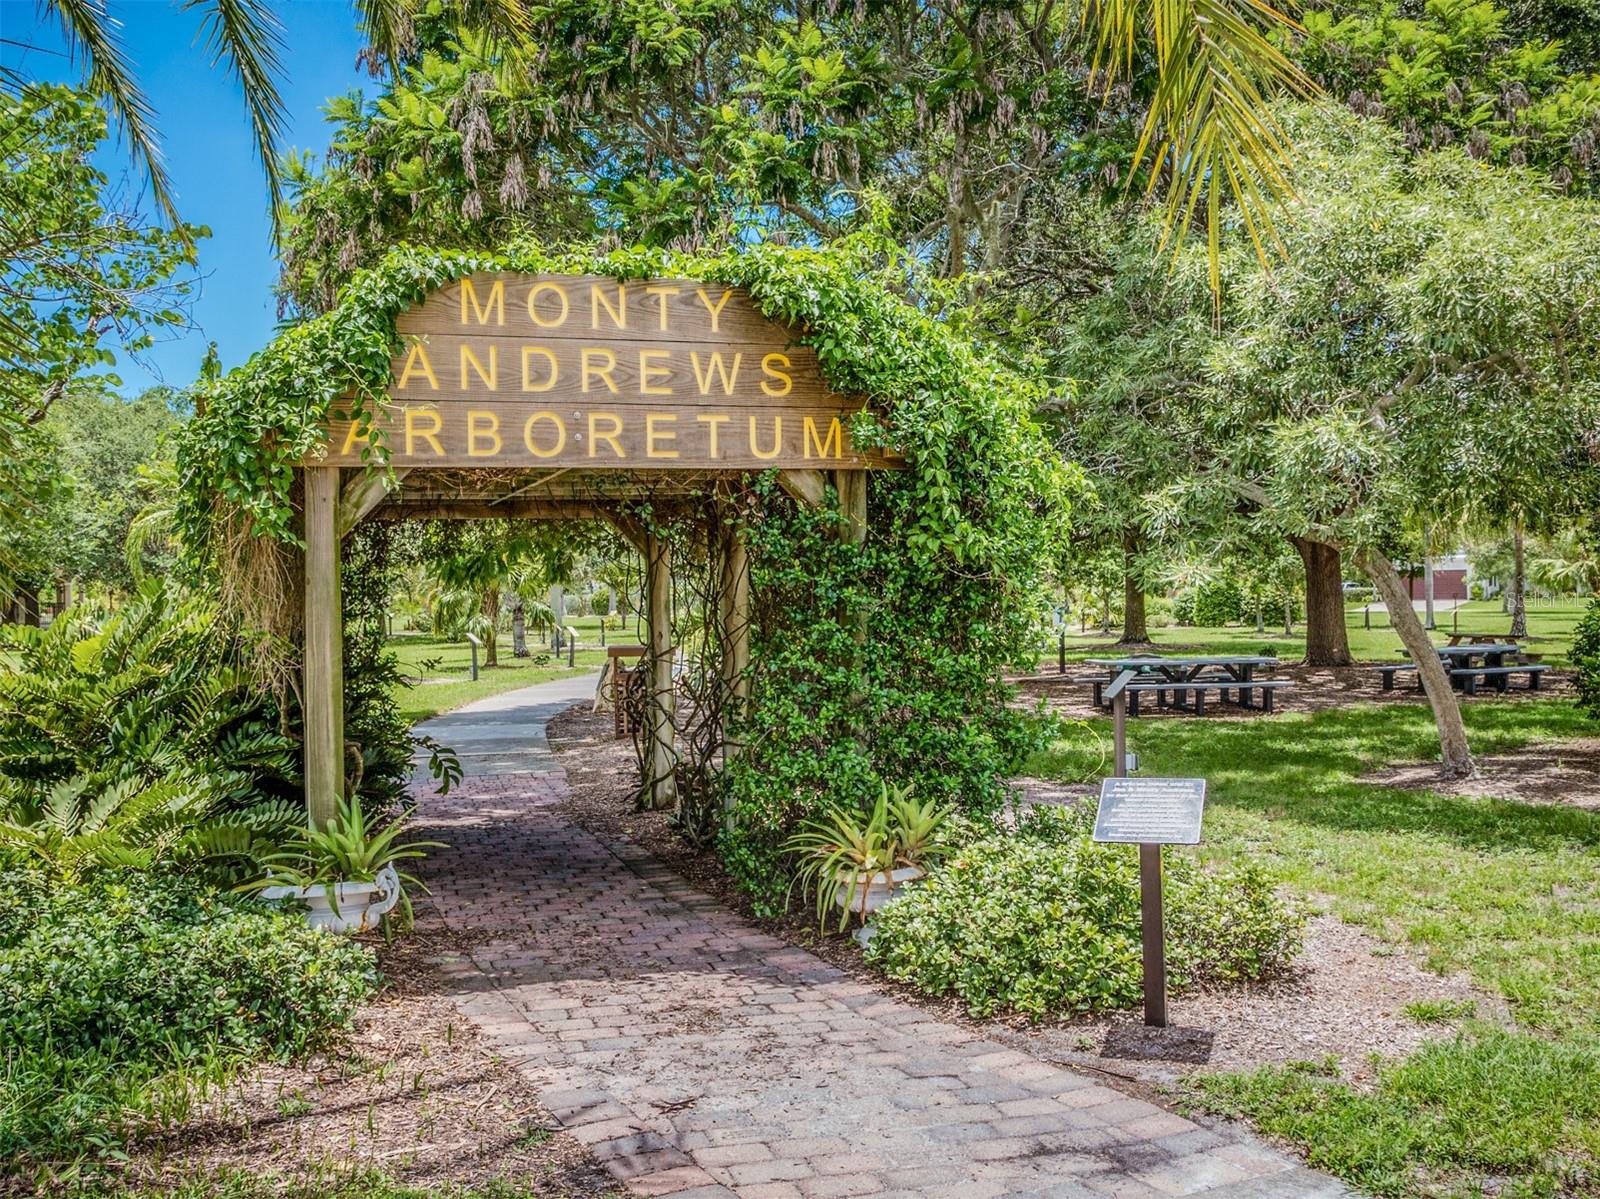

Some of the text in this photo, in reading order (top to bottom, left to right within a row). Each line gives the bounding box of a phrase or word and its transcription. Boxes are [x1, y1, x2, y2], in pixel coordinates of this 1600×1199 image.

[460, 278, 733, 333] MONTY
[398, 343, 793, 397] ANDREWS
[341, 408, 843, 460] ARBORETUM
